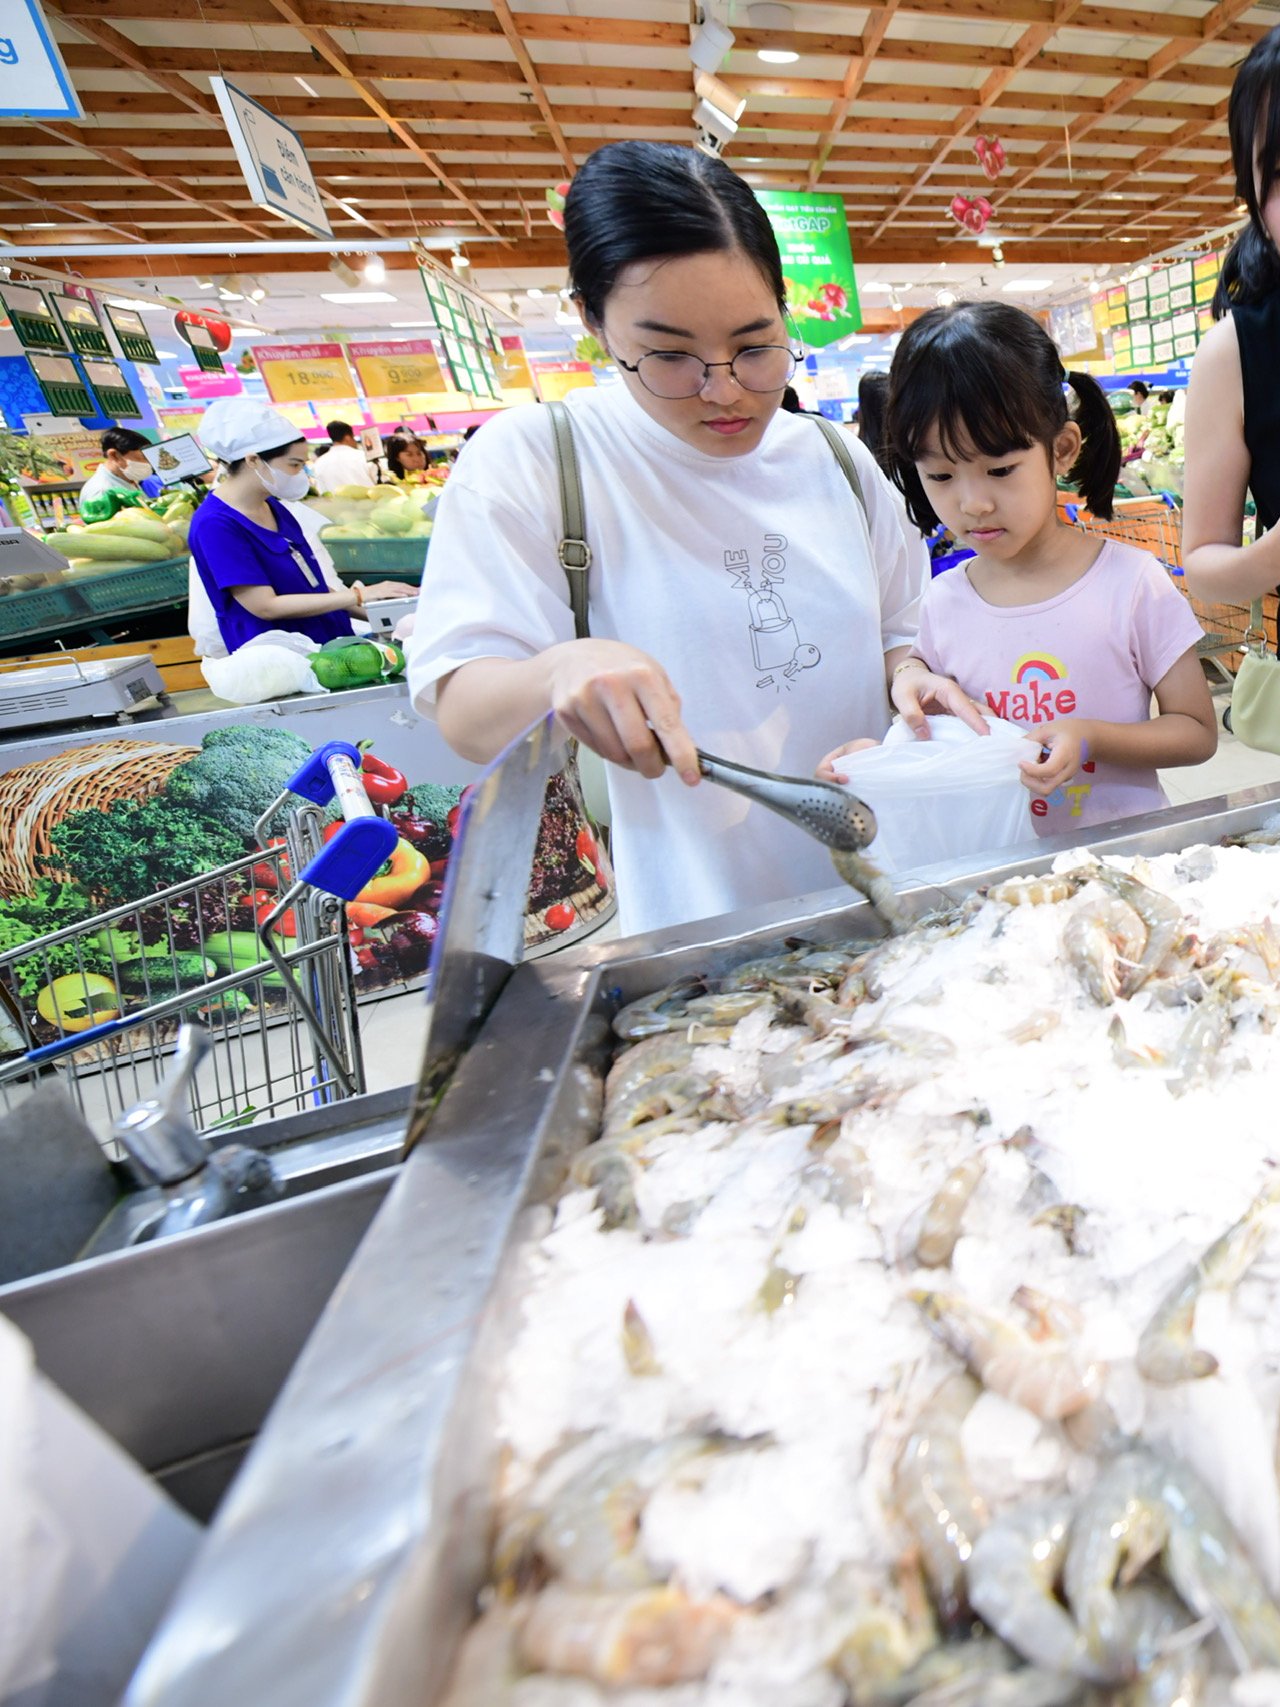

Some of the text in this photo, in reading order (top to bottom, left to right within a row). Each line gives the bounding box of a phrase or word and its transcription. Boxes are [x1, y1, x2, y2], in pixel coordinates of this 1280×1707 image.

[724, 549, 752, 589] ME
[761, 533, 789, 589] YOU
[985, 680, 1077, 723] Make
